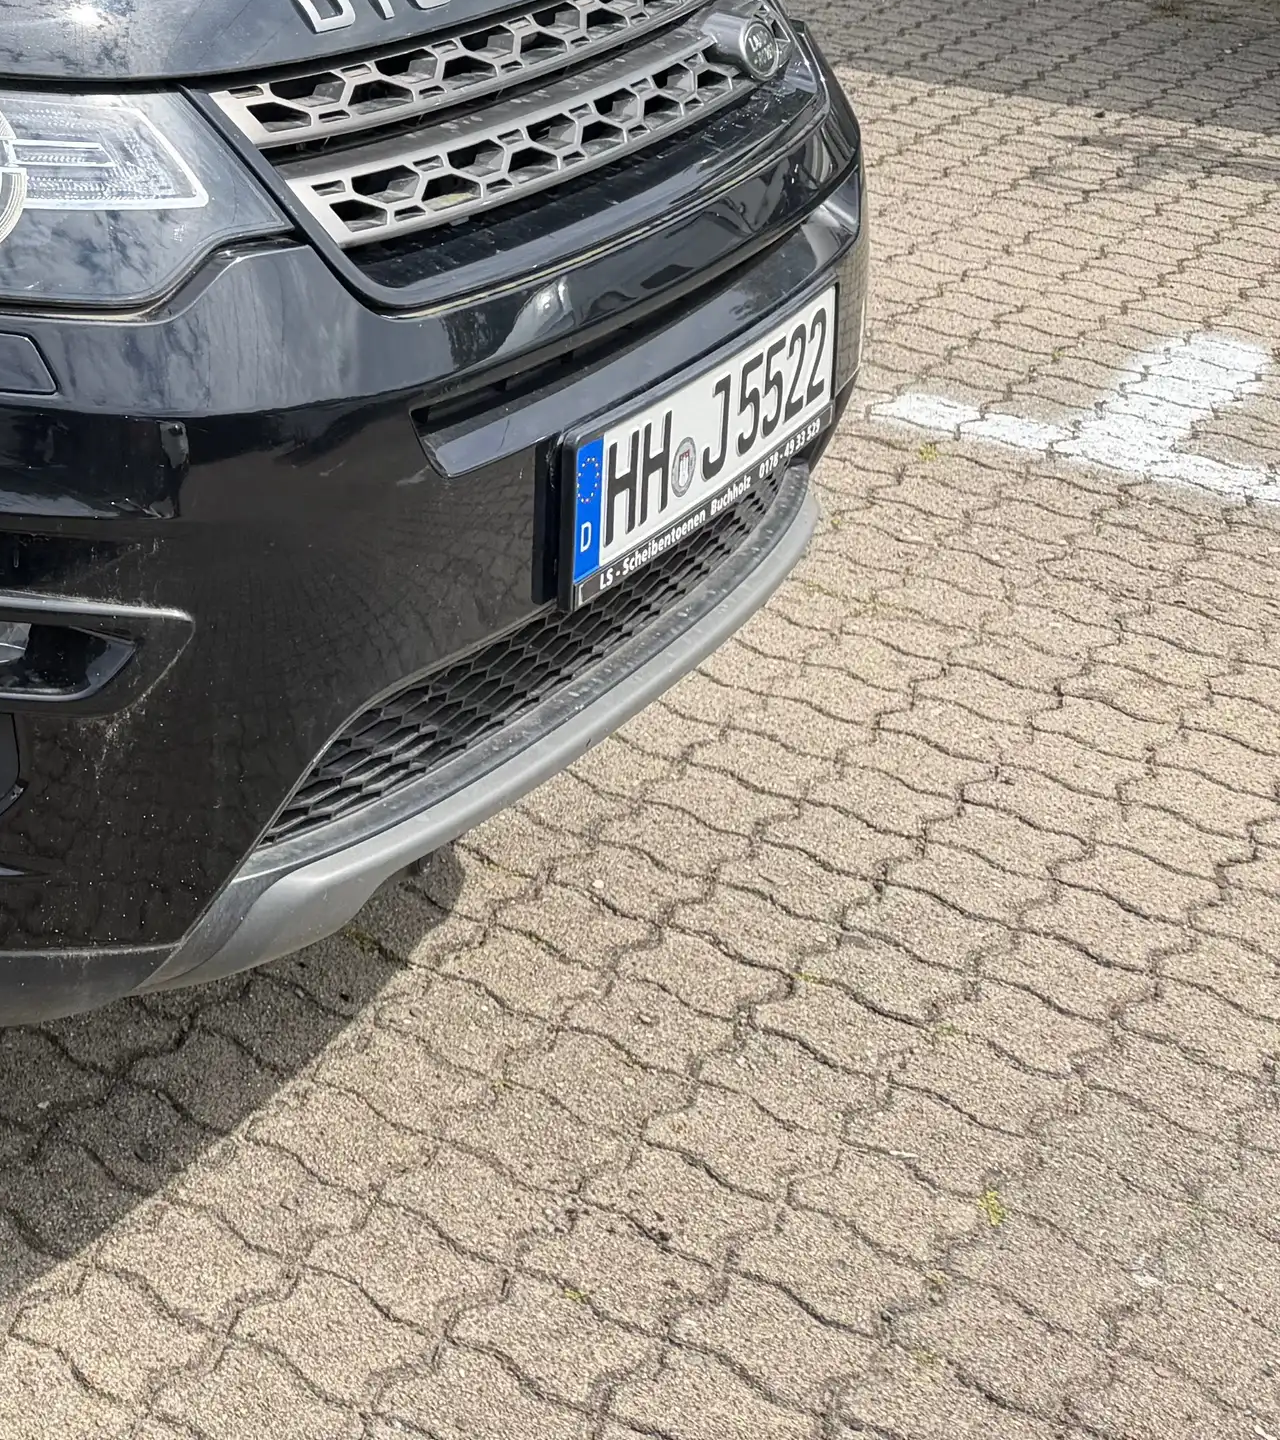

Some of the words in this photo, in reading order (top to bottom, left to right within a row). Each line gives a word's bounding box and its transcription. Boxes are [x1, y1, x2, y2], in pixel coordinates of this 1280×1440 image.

[580, 521, 593, 553] D
[600, 567, 613, 590] LS
[622, 509, 706, 576] Scheibentoenen
[710, 475, 751, 516] Buchholz
[602, 410, 673, 549] HH
